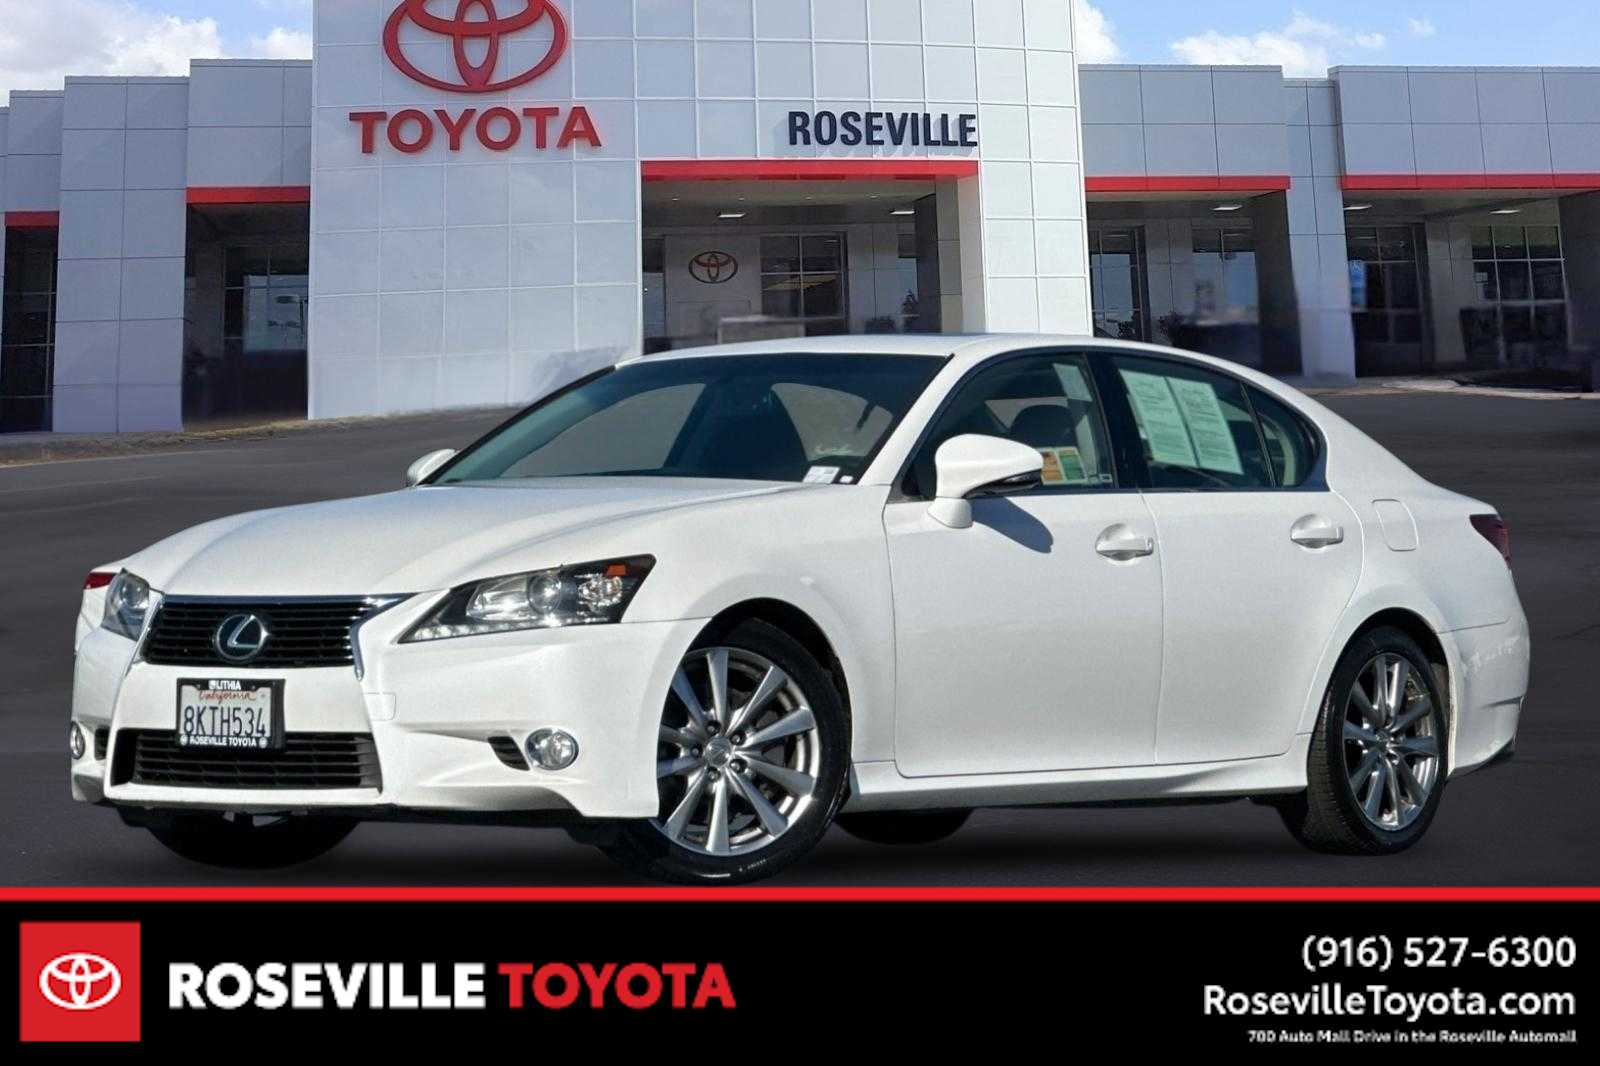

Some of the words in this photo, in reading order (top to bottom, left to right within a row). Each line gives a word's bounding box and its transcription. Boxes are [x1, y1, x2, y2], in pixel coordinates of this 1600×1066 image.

[350, 106, 602, 154] TOYOTA
[788, 111, 978, 147] ROSEVILLE
[184, 705, 266, 736] 8KTH534
[189, 735, 227, 746] ROSEVILLE
[229, 737, 257, 747] TOYOTA
